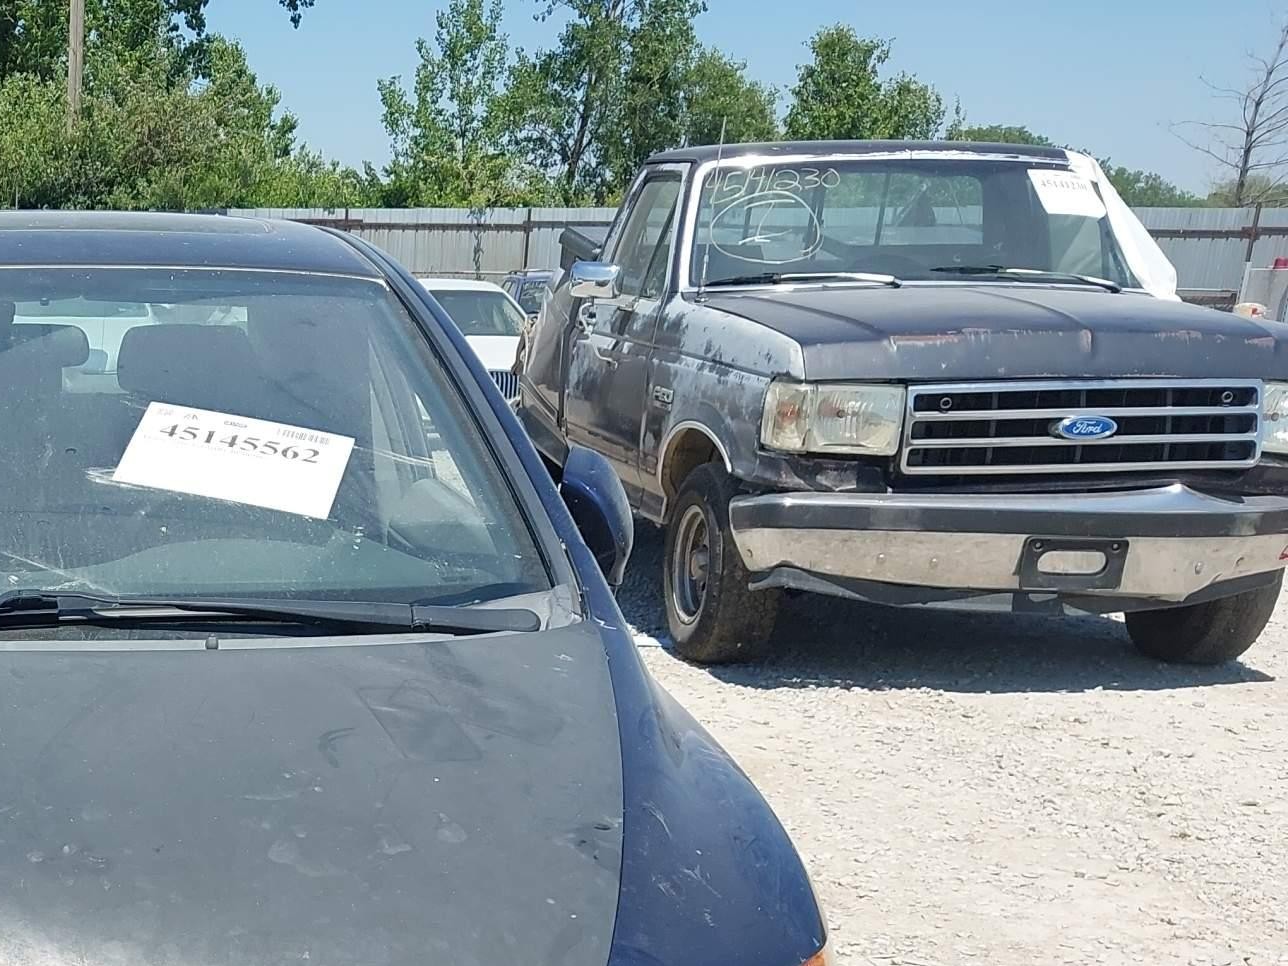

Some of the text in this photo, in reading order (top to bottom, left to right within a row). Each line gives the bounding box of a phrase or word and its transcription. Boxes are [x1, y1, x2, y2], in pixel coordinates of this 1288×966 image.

[705, 166, 841, 204] 45141230
[159, 423, 320, 464] 45145562
[1072, 420, 1104, 434] Ford
